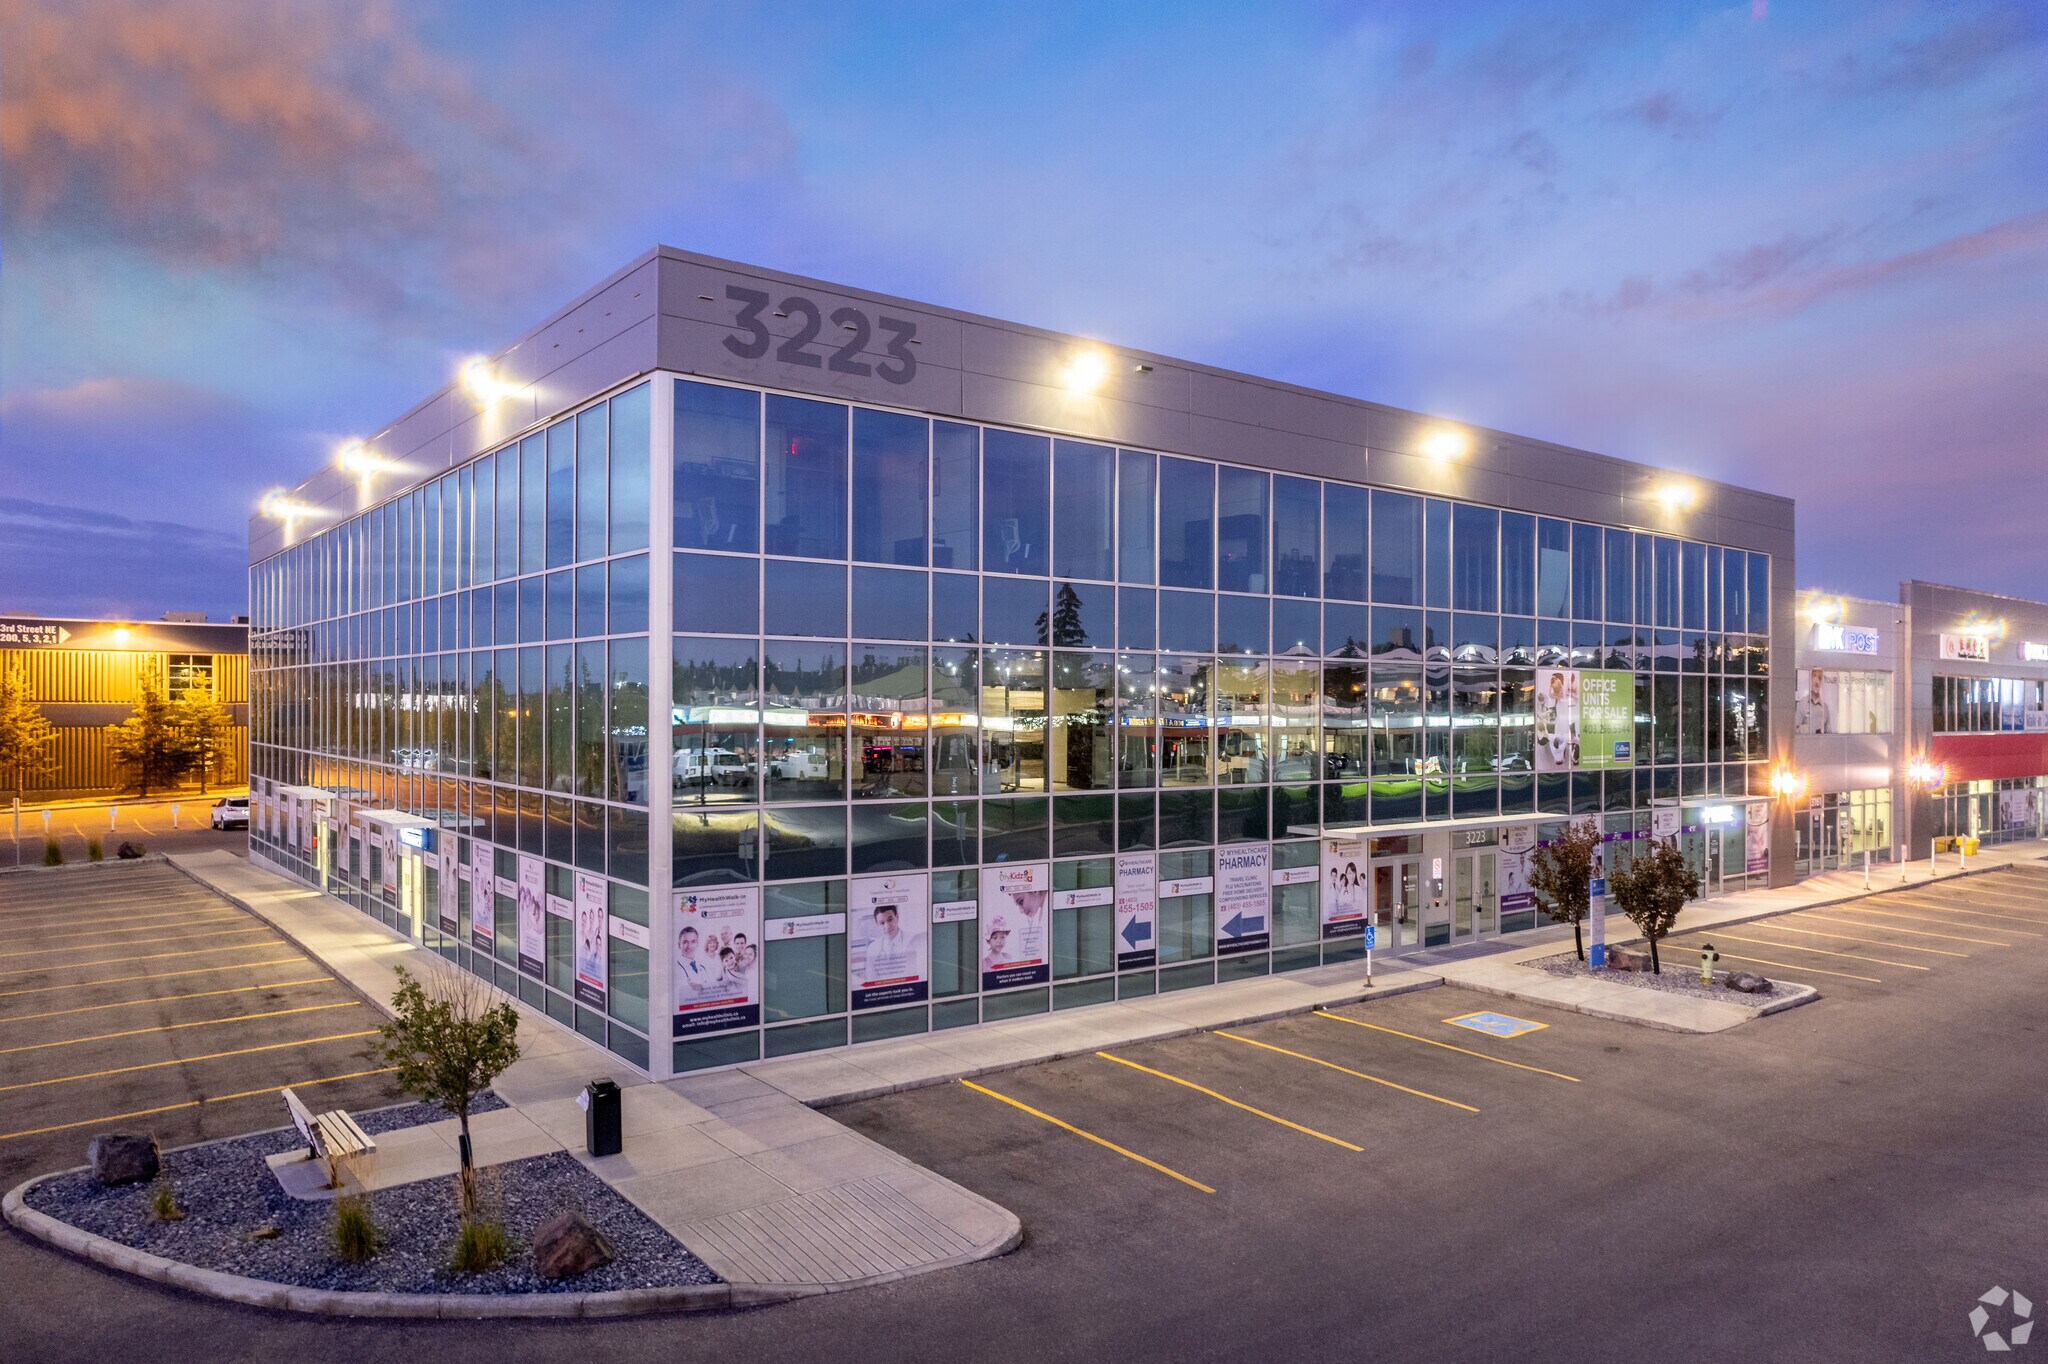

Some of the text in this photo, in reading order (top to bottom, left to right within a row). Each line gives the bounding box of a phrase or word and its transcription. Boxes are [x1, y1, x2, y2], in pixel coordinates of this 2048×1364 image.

[722, 284, 917, 385] 3223
[0, 624, 57, 634] 3rd Street NE
[1848, 632, 1880, 653] POST
[1583, 679, 1617, 693] OFFICE
[1583, 692, 1610, 706] UNITS
[1583, 706, 1628, 719] FOR SALE
[1465, 831, 1486, 844] 3223
[1226, 847, 1267, 855] MYHEALTHCARE
[1219, 854, 1268, 870] PHARMACY
[1119, 866, 1154, 877] PHARMACY
[1119, 901, 1154, 913] 455-1505
